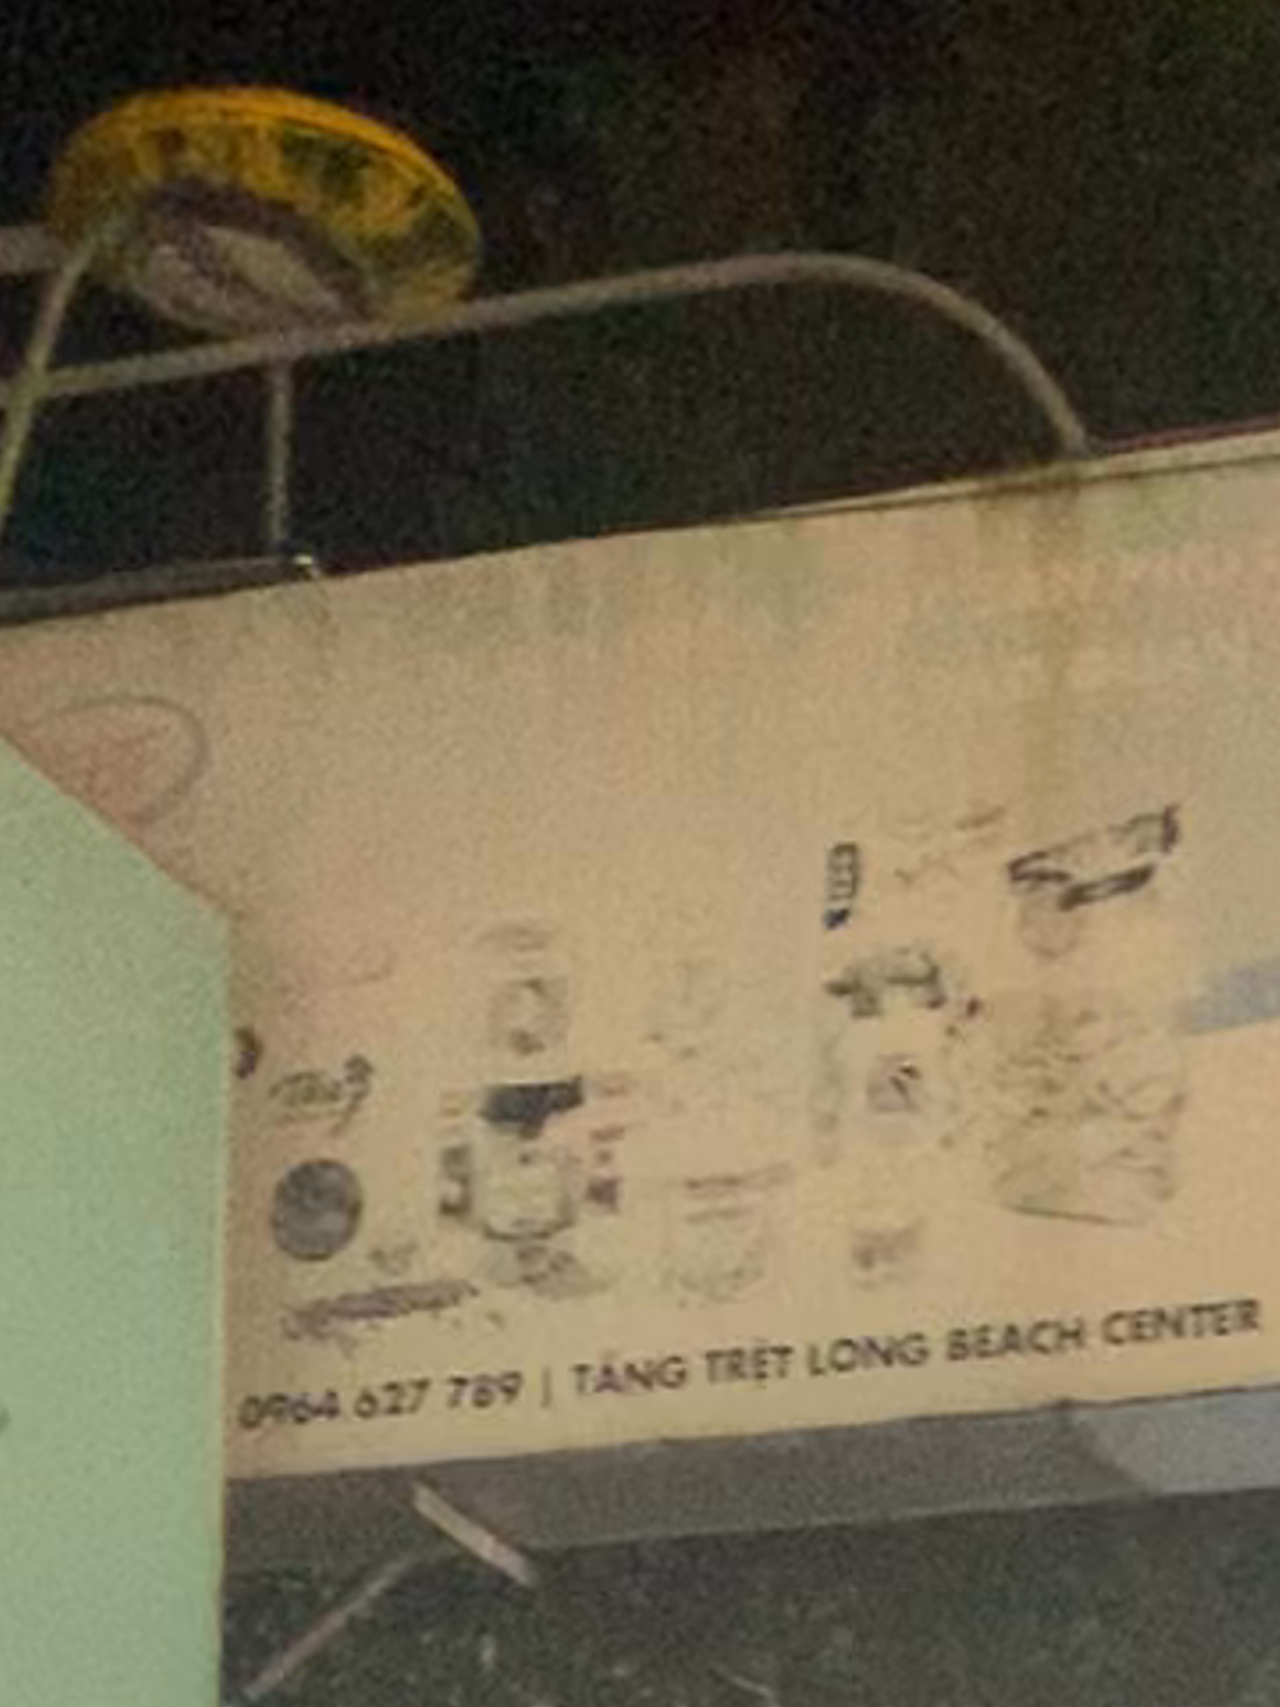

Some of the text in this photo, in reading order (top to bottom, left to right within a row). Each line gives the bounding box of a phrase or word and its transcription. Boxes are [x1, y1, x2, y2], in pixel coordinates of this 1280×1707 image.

[238, 1390, 340, 1430] 0964
[354, 1378, 430, 1419] 627
[446, 1371, 524, 1409] 789
[808, 1333, 929, 1376] LONG
[945, 1314, 1088, 1362] BEACH
[1101, 1298, 1261, 1347] CENTER
